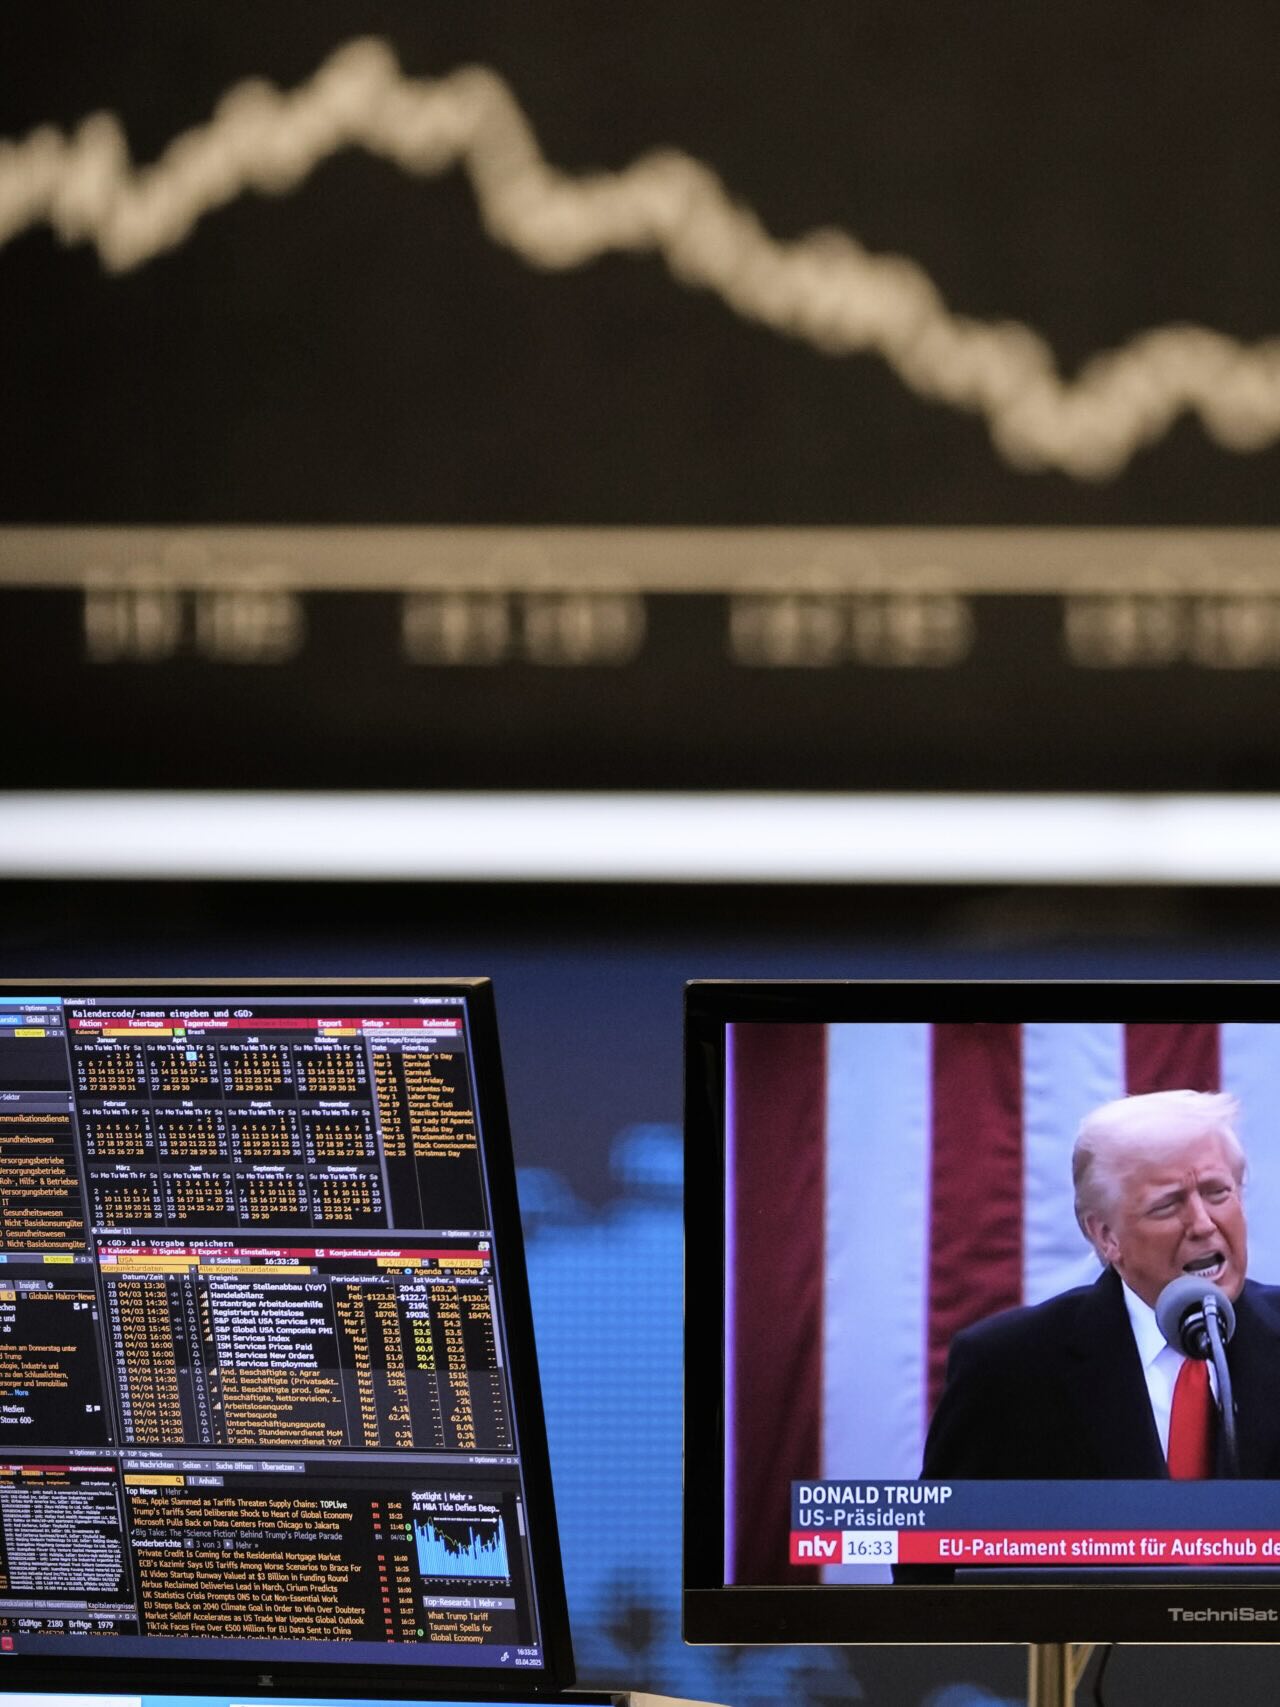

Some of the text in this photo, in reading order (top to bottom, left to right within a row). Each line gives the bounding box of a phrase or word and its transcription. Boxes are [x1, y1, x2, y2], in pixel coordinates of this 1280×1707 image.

[169, 1010, 209, 1019] eingeben
[128, 1020, 163, 1028] Feiertage
[183, 1020, 228, 1028] Tagerechner
[317, 1020, 342, 1028] Export
[362, 1020, 383, 1028] Setup
[150, 1240, 184, 1248] Vorgabe
[189, 1240, 233, 1249] speichern
[19, 1282, 40, 1291] Insight
[210, 1283, 250, 1292] Challenger
[304, 1284, 326, 1293] (YoY)
[126, 1487, 138, 1497] Top
[139, 1488, 157, 1496] News
[412, 1492, 441, 1502] Spotlight
[800, 1486, 952, 1504] DONALD TRUMP
[132, 1497, 148, 1507] Nike,
[150, 1498, 168, 1507] Apple
[170, 1498, 201, 1506] Slammed
[213, 1499, 235, 1507] Tariffs
[237, 1499, 267, 1507] Threaten
[268, 1500, 291, 1510] Supply
[292, 1500, 317, 1508] Chains:
[320, 1501, 347, 1509] TOPLive
[133, 1508, 352, 1522] Trump's Tariffs Send Deliberate Shock to Heart of Global Economy
[800, 1508, 925, 1526] US-Präsident
[134, 1519, 164, 1527] Microsoft
[166, 1519, 183, 1527] Pulls
[213, 1520, 228, 1528] Data
[230, 1520, 256, 1528] Centers
[257, 1521, 275, 1529] From
[276, 1521, 303, 1531] Chicago
[314, 1522, 339, 1530] Jakarta
[132, 1539, 181, 1548] Sonderberichte
[798, 1535, 837, 1557] ntv
[848, 1541, 893, 1556] 16:33
[939, 1538, 1066, 1556] EU-Parlament
[1071, 1538, 1135, 1556] stimmt
[1140, 1538, 1166, 1556] für
[1171, 1538, 1256, 1556] Aufschub
[138, 1550, 341, 1563] Private Credit Is Coming for the Residential Mortgage Market
[424, 1598, 470, 1608] Top-Research
[428, 1612, 488, 1622] What Trump Tariff
[1168, 1607, 1278, 1621] TechniSat
[47, 1620, 63, 1628] 2180
[429, 1623, 492, 1634] Tsunami Spells for
[431, 1634, 484, 1644] Global Economy
